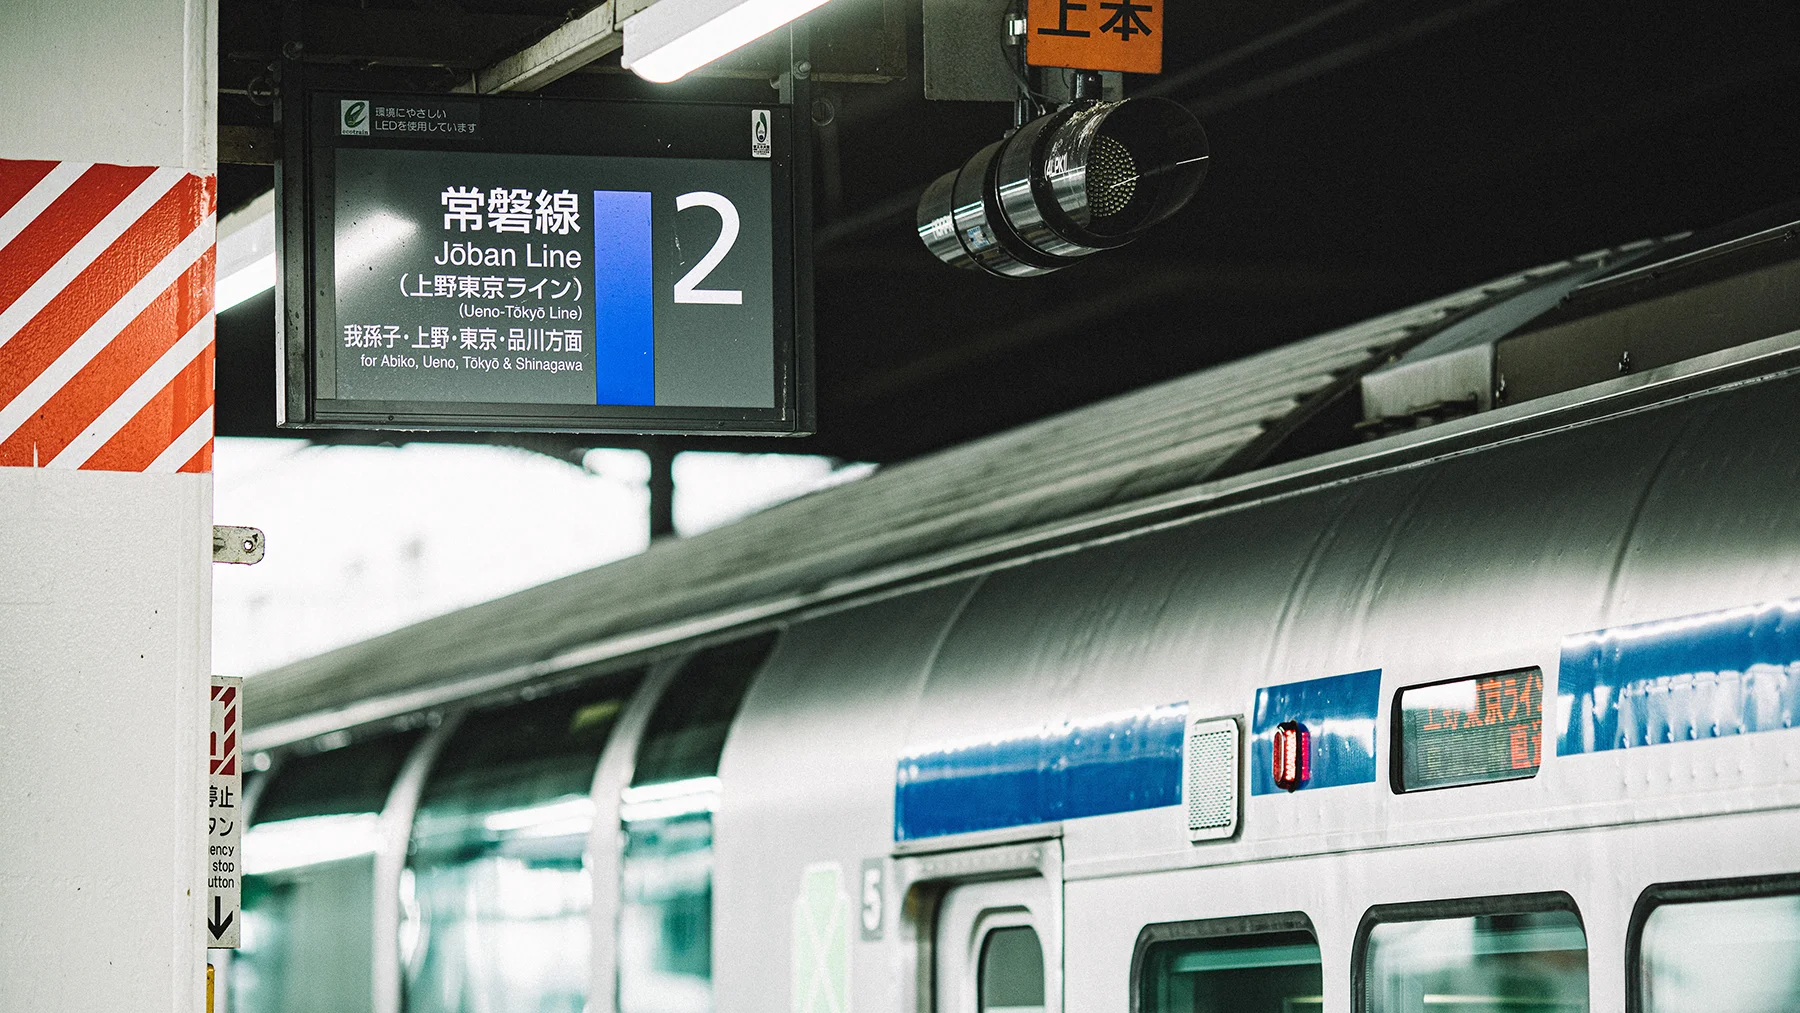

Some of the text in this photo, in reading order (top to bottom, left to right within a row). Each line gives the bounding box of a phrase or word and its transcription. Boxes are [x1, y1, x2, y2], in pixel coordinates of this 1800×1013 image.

[375, 107, 447, 119] 環境にやさしい
[375, 120, 477, 134] LEDを使用しています
[441, 186, 581, 235] 常磐線
[434, 241, 582, 269] Jōban Line
[673, 191, 743, 305] 2
[400, 273, 582, 301] （上野東京ライン）
[459, 303, 583, 322] (Ueno-Tōkyō Line)
[344, 324, 583, 353] 我孫子・上野・東京・品川方面
[360, 354, 584, 374] for Abiko, Ueno, Tōkyō & Shinagawa
[209, 845, 234, 857] ency
[212, 860, 235, 873] stop
[208, 876, 235, 889] utton
[863, 868, 881, 931] 5
